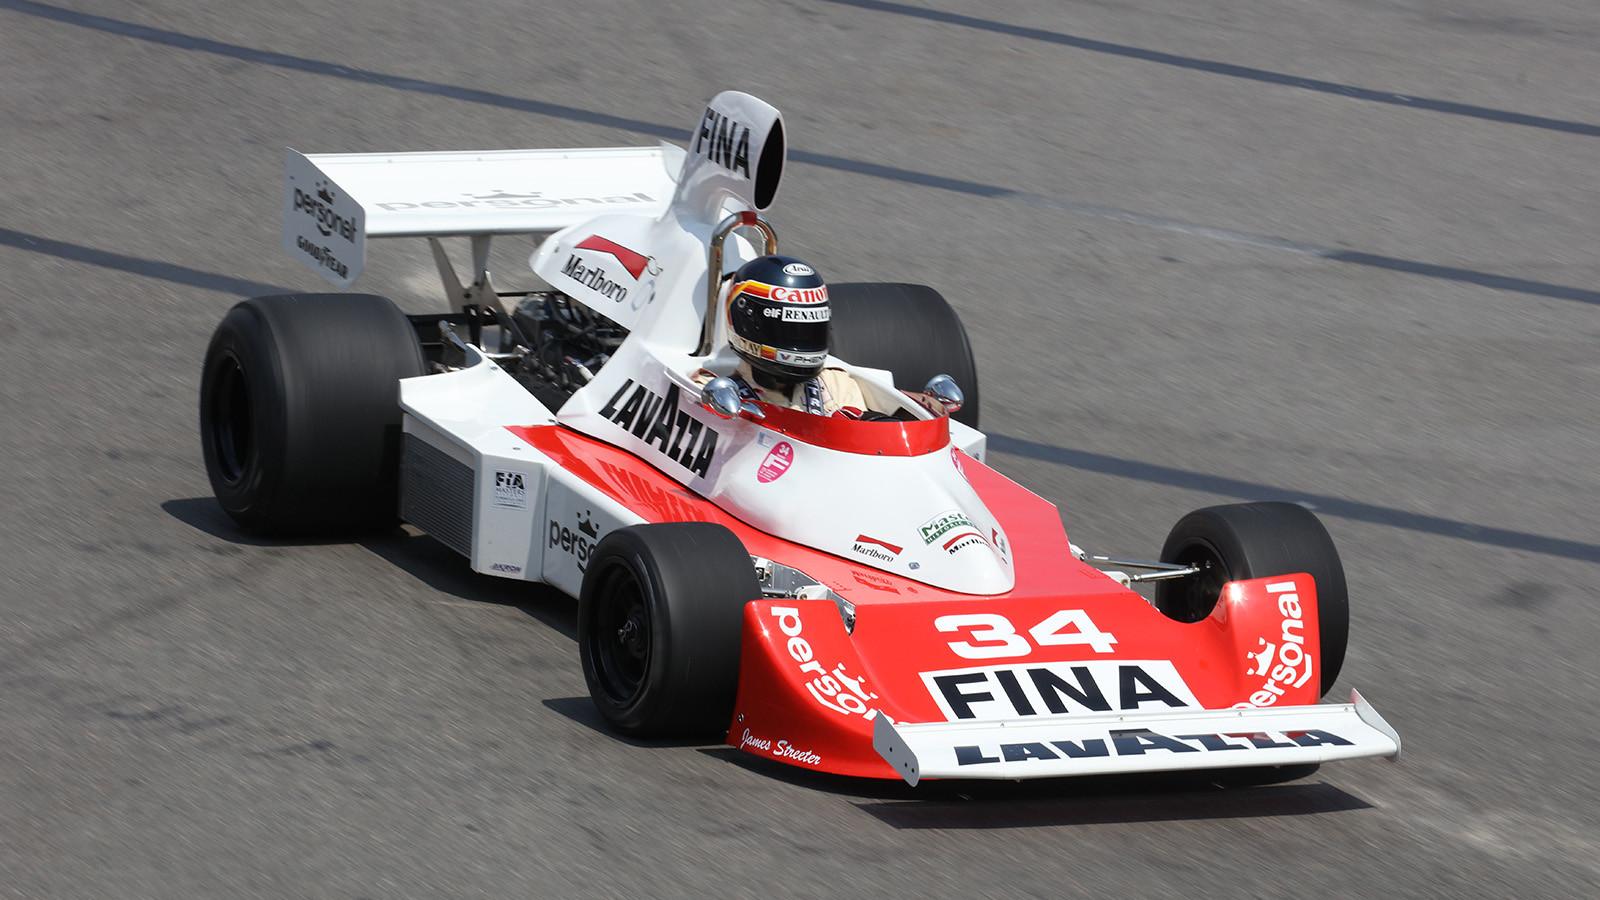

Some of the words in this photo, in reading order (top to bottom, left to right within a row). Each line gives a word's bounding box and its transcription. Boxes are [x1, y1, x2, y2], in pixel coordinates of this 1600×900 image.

[696, 107, 752, 180] FINA
[294, 187, 357, 244] personal
[375, 192, 657, 211] personal
[560, 253, 628, 303] Marlboro
[771, 287, 829, 303] Canon
[763, 307, 782, 319] elf
[598, 378, 719, 480] LAVAZZA
[850, 542, 894, 563] Marlboro
[948, 538, 991, 556] Marl
[934, 609, 1119, 660] 34
[933, 664, 1190, 720] FINA
[740, 727, 771, 751] James
[773, 740, 821, 765] Streeter
[954, 728, 1356, 766] LAVAZZA
